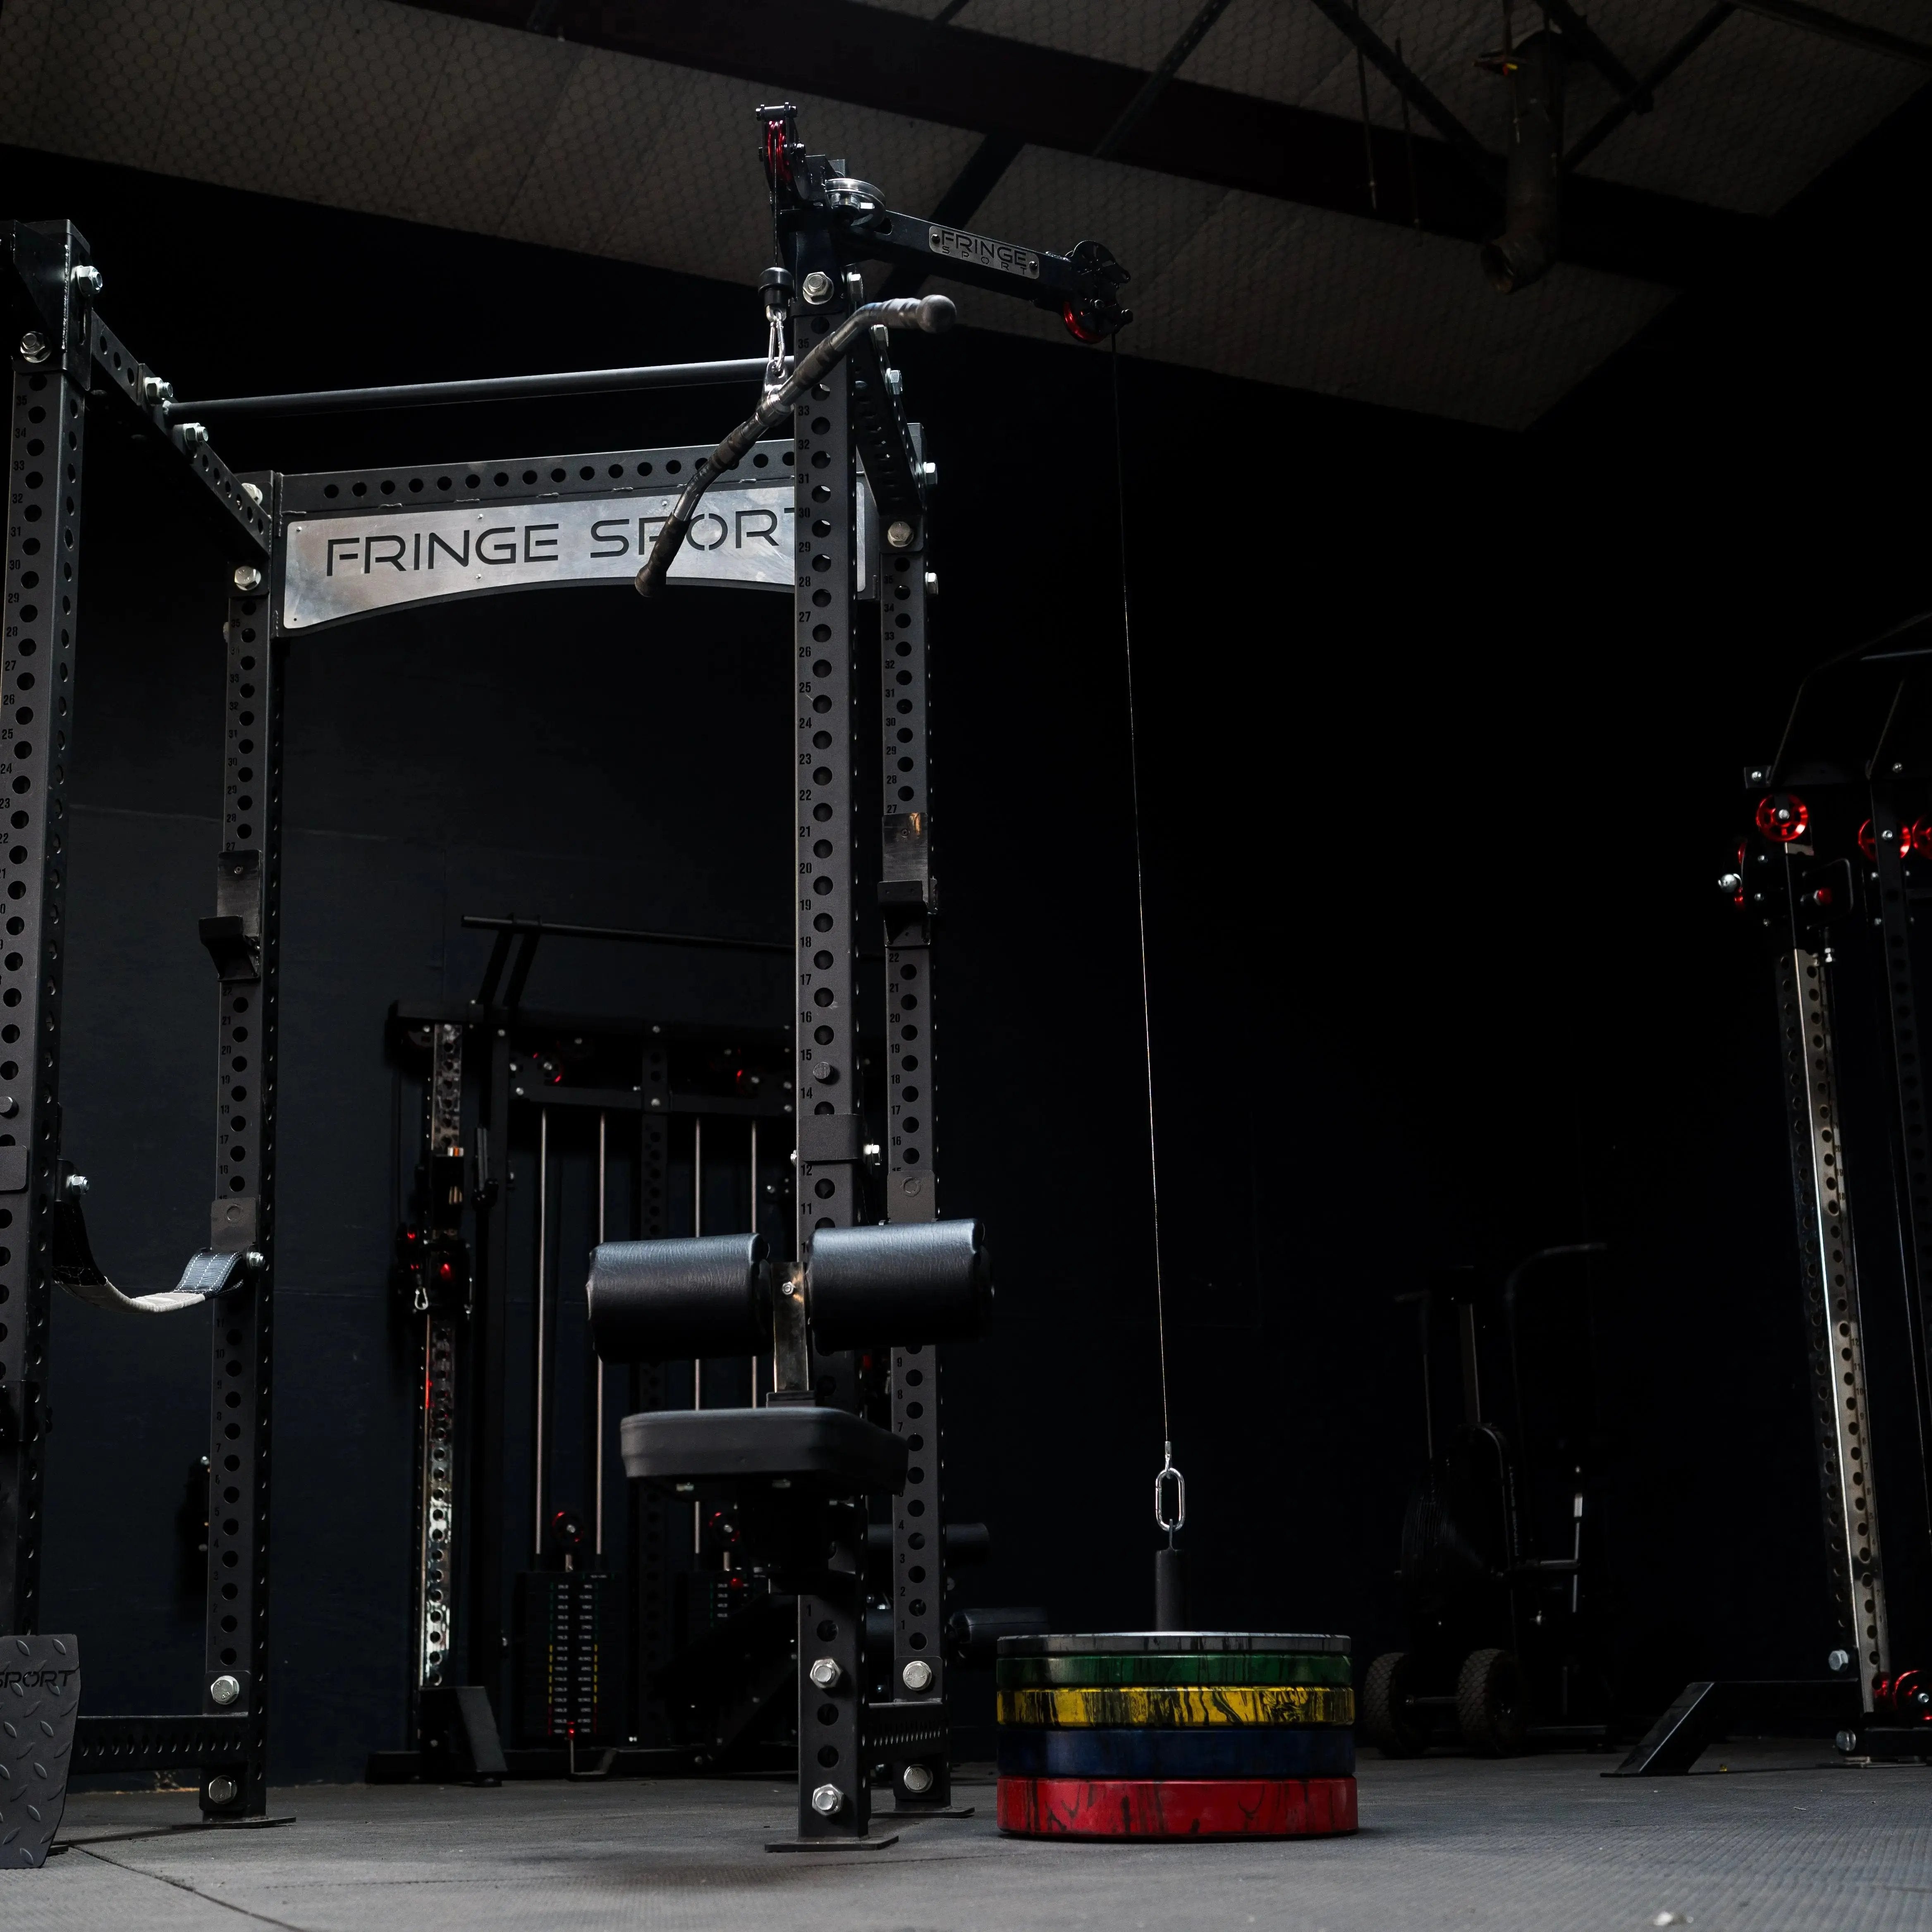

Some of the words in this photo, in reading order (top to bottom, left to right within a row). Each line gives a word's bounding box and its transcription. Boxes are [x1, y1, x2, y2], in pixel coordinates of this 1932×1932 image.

[942, 230, 1027, 267] FRINGE
[942, 246, 1026, 275] SPORT
[799, 338, 809, 349] 35
[17, 396, 27, 406] 35
[799, 406, 809, 416] 33
[15, 428, 26, 438] 34
[799, 440, 809, 450] 32
[14, 460, 24, 471] 33
[799, 474, 808, 483] 31
[13, 493, 22, 503] 32
[799, 508, 810, 518] 30
[11, 527, 20, 537] 31
[327, 524, 559, 576] FRINGE
[591, 507, 794, 558] SPOR
[799, 542, 810, 552] 29
[10, 560, 20, 570] 30
[799, 576, 811, 587] 28
[8, 593, 19, 603] 29
[885, 604, 894, 612] 34
[799, 612, 811, 622] 27
[232, 619, 240, 627] 35
[7, 626, 17, 637] 28
[885, 632, 894, 640] 33
[799, 647, 811, 657] 26
[5, 660, 16, 671] 27
[885, 660, 894, 669] 32
[799, 682, 811, 693] 25
[886, 689, 894, 697] 31
[4, 694, 14, 705] 26
[230, 702, 238, 710] 32
[800, 717, 812, 728] 24
[886, 718, 895, 726] 30
[2, 729, 13, 739] 25
[229, 730, 237, 738] 31
[887, 746, 896, 755] 29
[228, 758, 237, 766] 30
[800, 753, 811, 764] 23
[1, 763, 12, 774] 24
[887, 775, 897, 784] 28
[228, 785, 237, 794] 29
[800, 790, 811, 800] 22
[0, 798, 10, 809] 23
[887, 805, 897, 813] 27
[800, 826, 810, 837] 21
[227, 842, 235, 851] 27
[800, 863, 811, 873] 20
[800, 899, 811, 910] 19
[801, 937, 811, 947] 18
[889, 953, 899, 962] 22
[801, 974, 811, 985] 17
[890, 983, 898, 992] 21
[222, 1016, 230, 1025] 21
[801, 1011, 811, 1022] 16
[890, 1014, 900, 1023] 20
[222, 1046, 231, 1054] 20
[891, 1044, 899, 1053] 19
[801, 1049, 811, 1060] 15
[222, 1075, 230, 1084] 19
[892, 1075, 900, 1084] 18
[801, 1088, 812, 1098] 14
[892, 1105, 900, 1114] 17
[220, 1135, 228, 1144] 17
[892, 1136, 901, 1145] 16
[220, 1165, 228, 1174] 16
[801, 1165, 812, 1176] 12
[801, 1203, 811, 1214] 11
[217, 1318, 224, 1327] 11
[216, 1349, 224, 1358] 10
[897, 1358, 902, 1367] 9
[217, 1380, 221, 1389] 9
[898, 1390, 902, 1399] 8
[217, 1412, 221, 1420] 8
[898, 1422, 903, 1432] 7
[217, 1443, 221, 1452] 7
[899, 1520, 904, 1530] 4
[900, 1554, 904, 1563] 3
[901, 1587, 905, 1596] 2
[901, 1620, 904, 1629] 1
